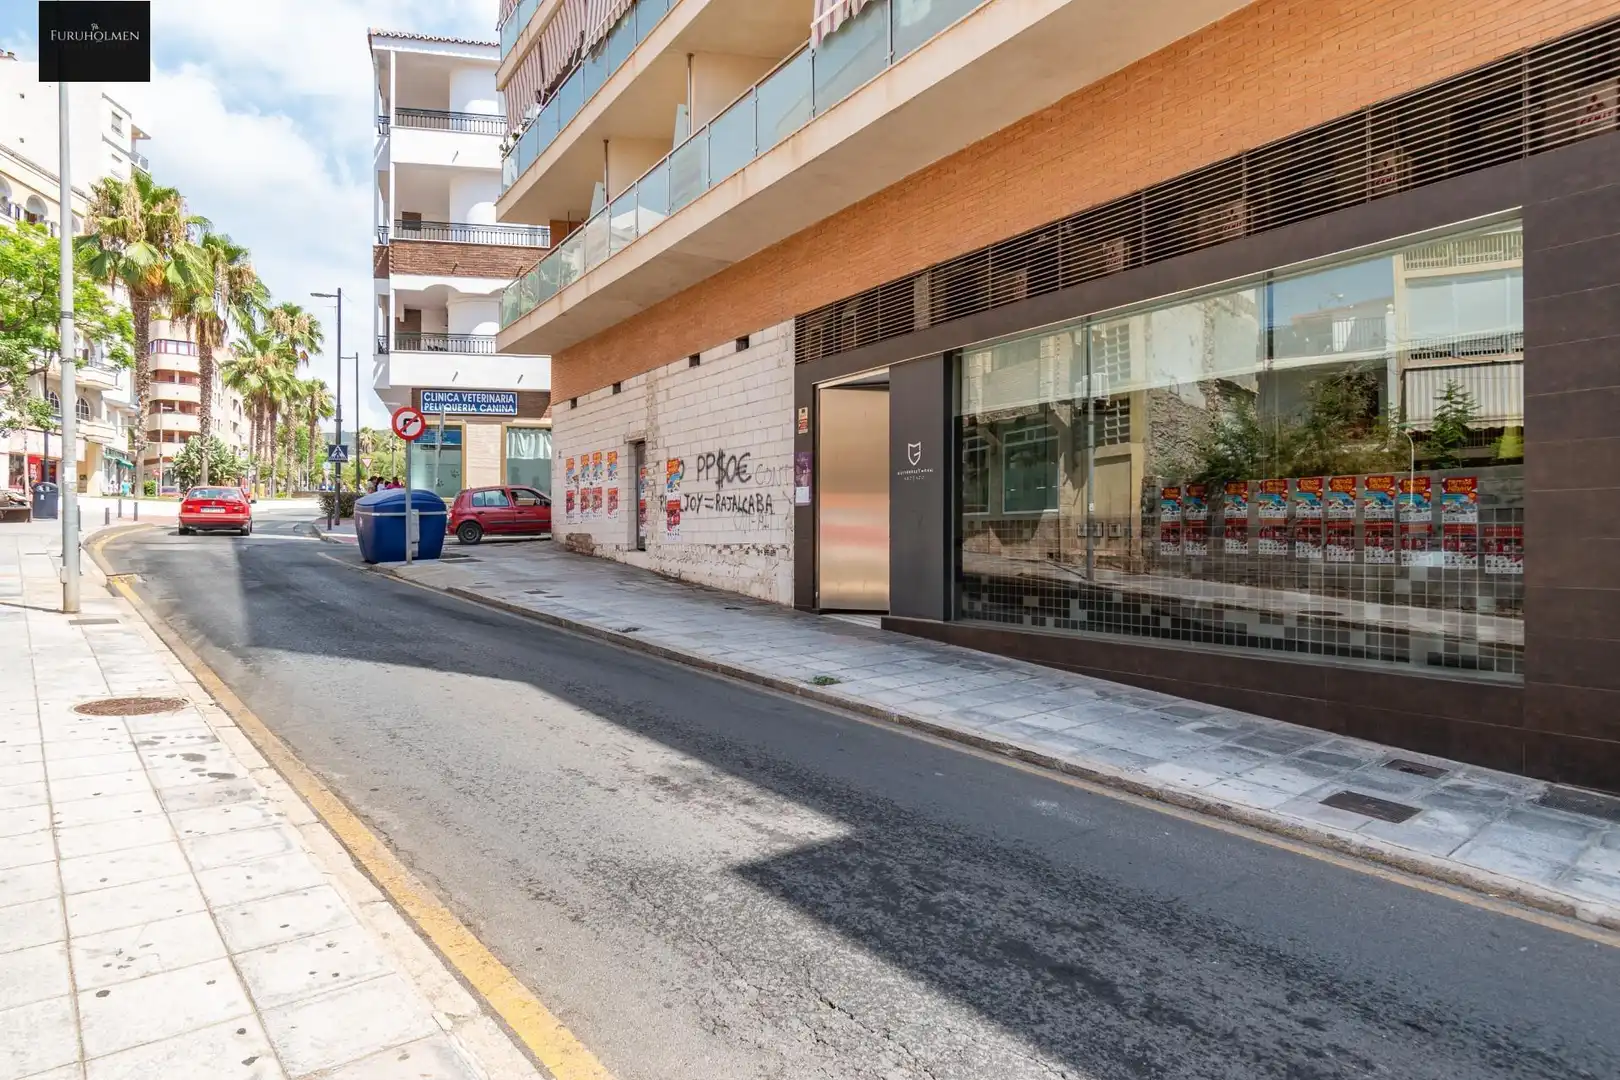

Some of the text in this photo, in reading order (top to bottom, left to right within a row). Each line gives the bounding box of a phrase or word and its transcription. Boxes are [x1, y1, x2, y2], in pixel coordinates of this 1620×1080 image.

[423, 391, 515, 404] CLINICA VETERINARIA
[479, 403, 515, 413] CANINA
